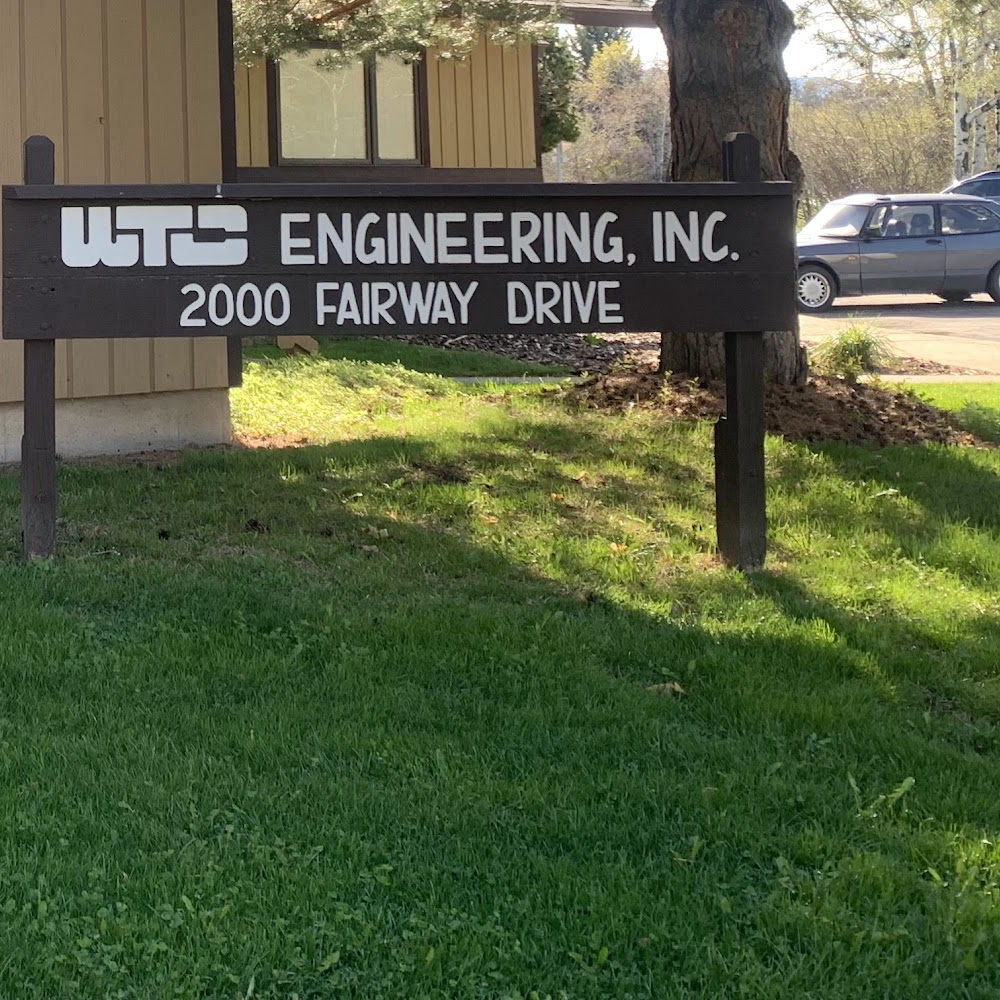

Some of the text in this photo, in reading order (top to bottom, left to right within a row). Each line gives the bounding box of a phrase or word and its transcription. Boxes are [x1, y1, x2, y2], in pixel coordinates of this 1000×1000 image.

[60, 204, 740, 267] WTC ENGINEERING, INC.
[179, 280, 625, 327] 2000 FAIRWAY DRIVE
